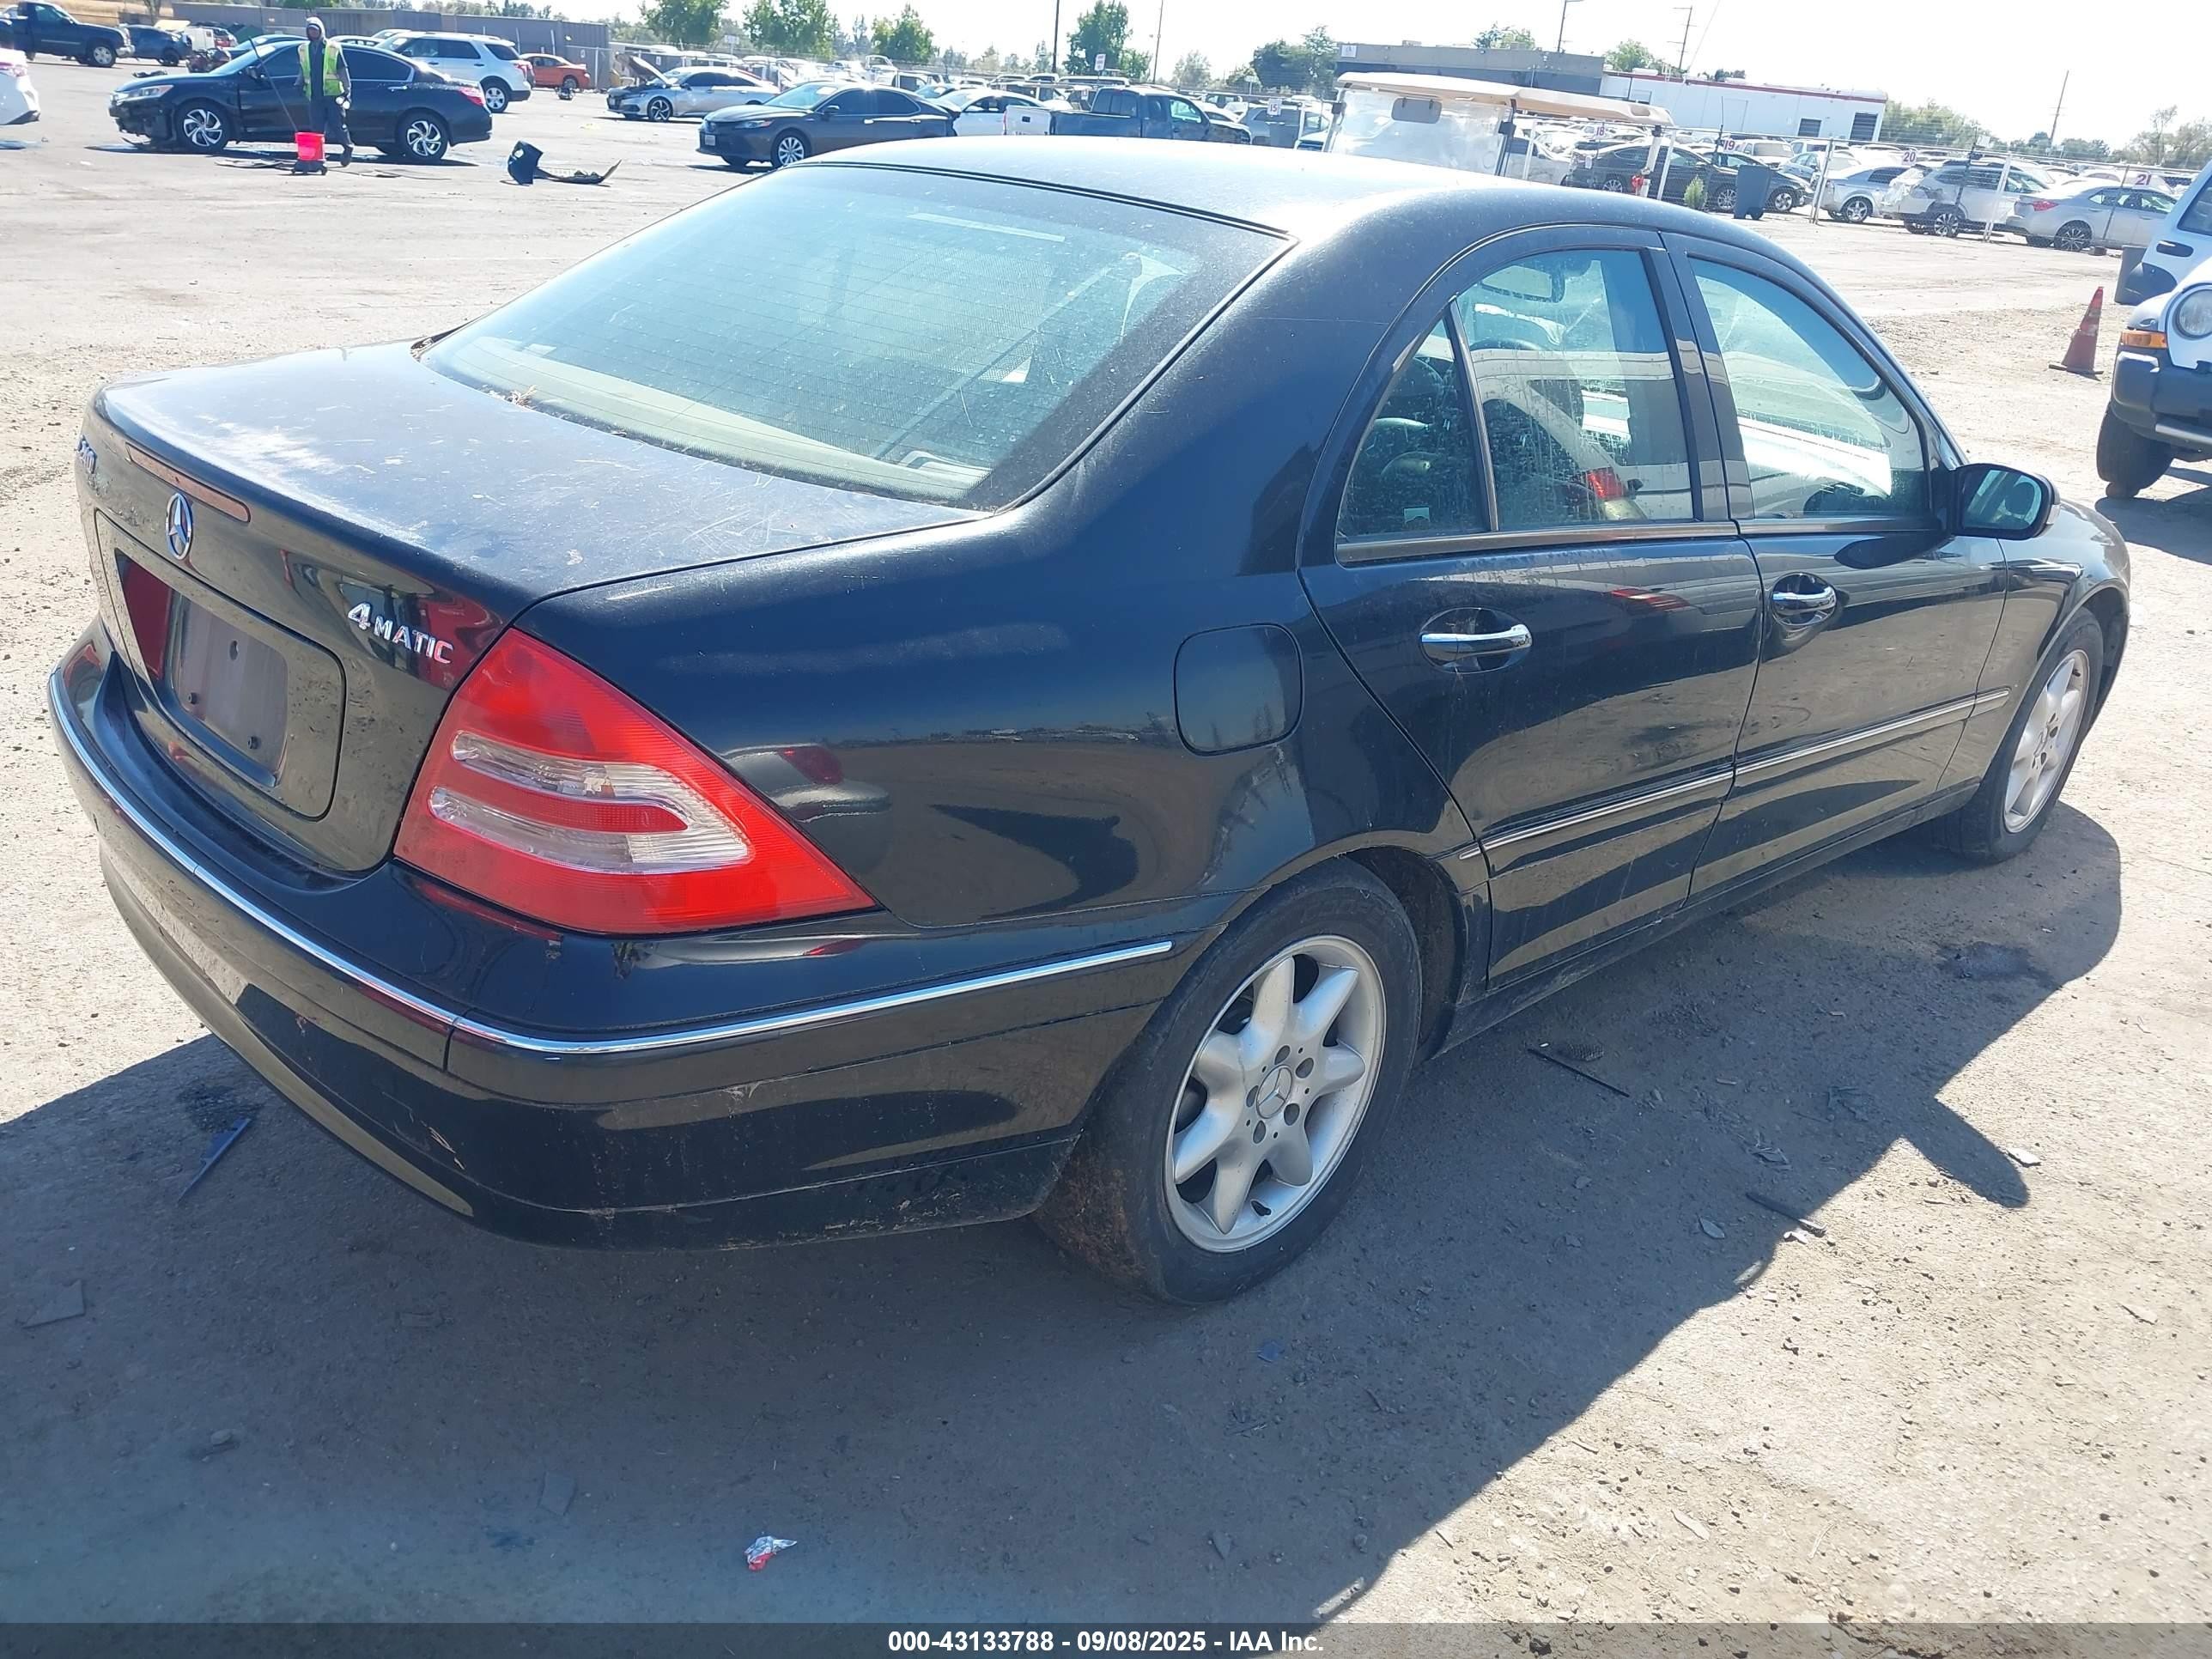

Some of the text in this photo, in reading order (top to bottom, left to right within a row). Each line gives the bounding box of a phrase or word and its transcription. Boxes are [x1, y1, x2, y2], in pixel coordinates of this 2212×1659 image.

[1269, 103, 1279, 112] 15
[1596, 126, 1606, 137] 18
[1723, 140, 1735, 151] 19
[1903, 150, 1917, 162] 20
[2135, 173, 2153, 186] 21
